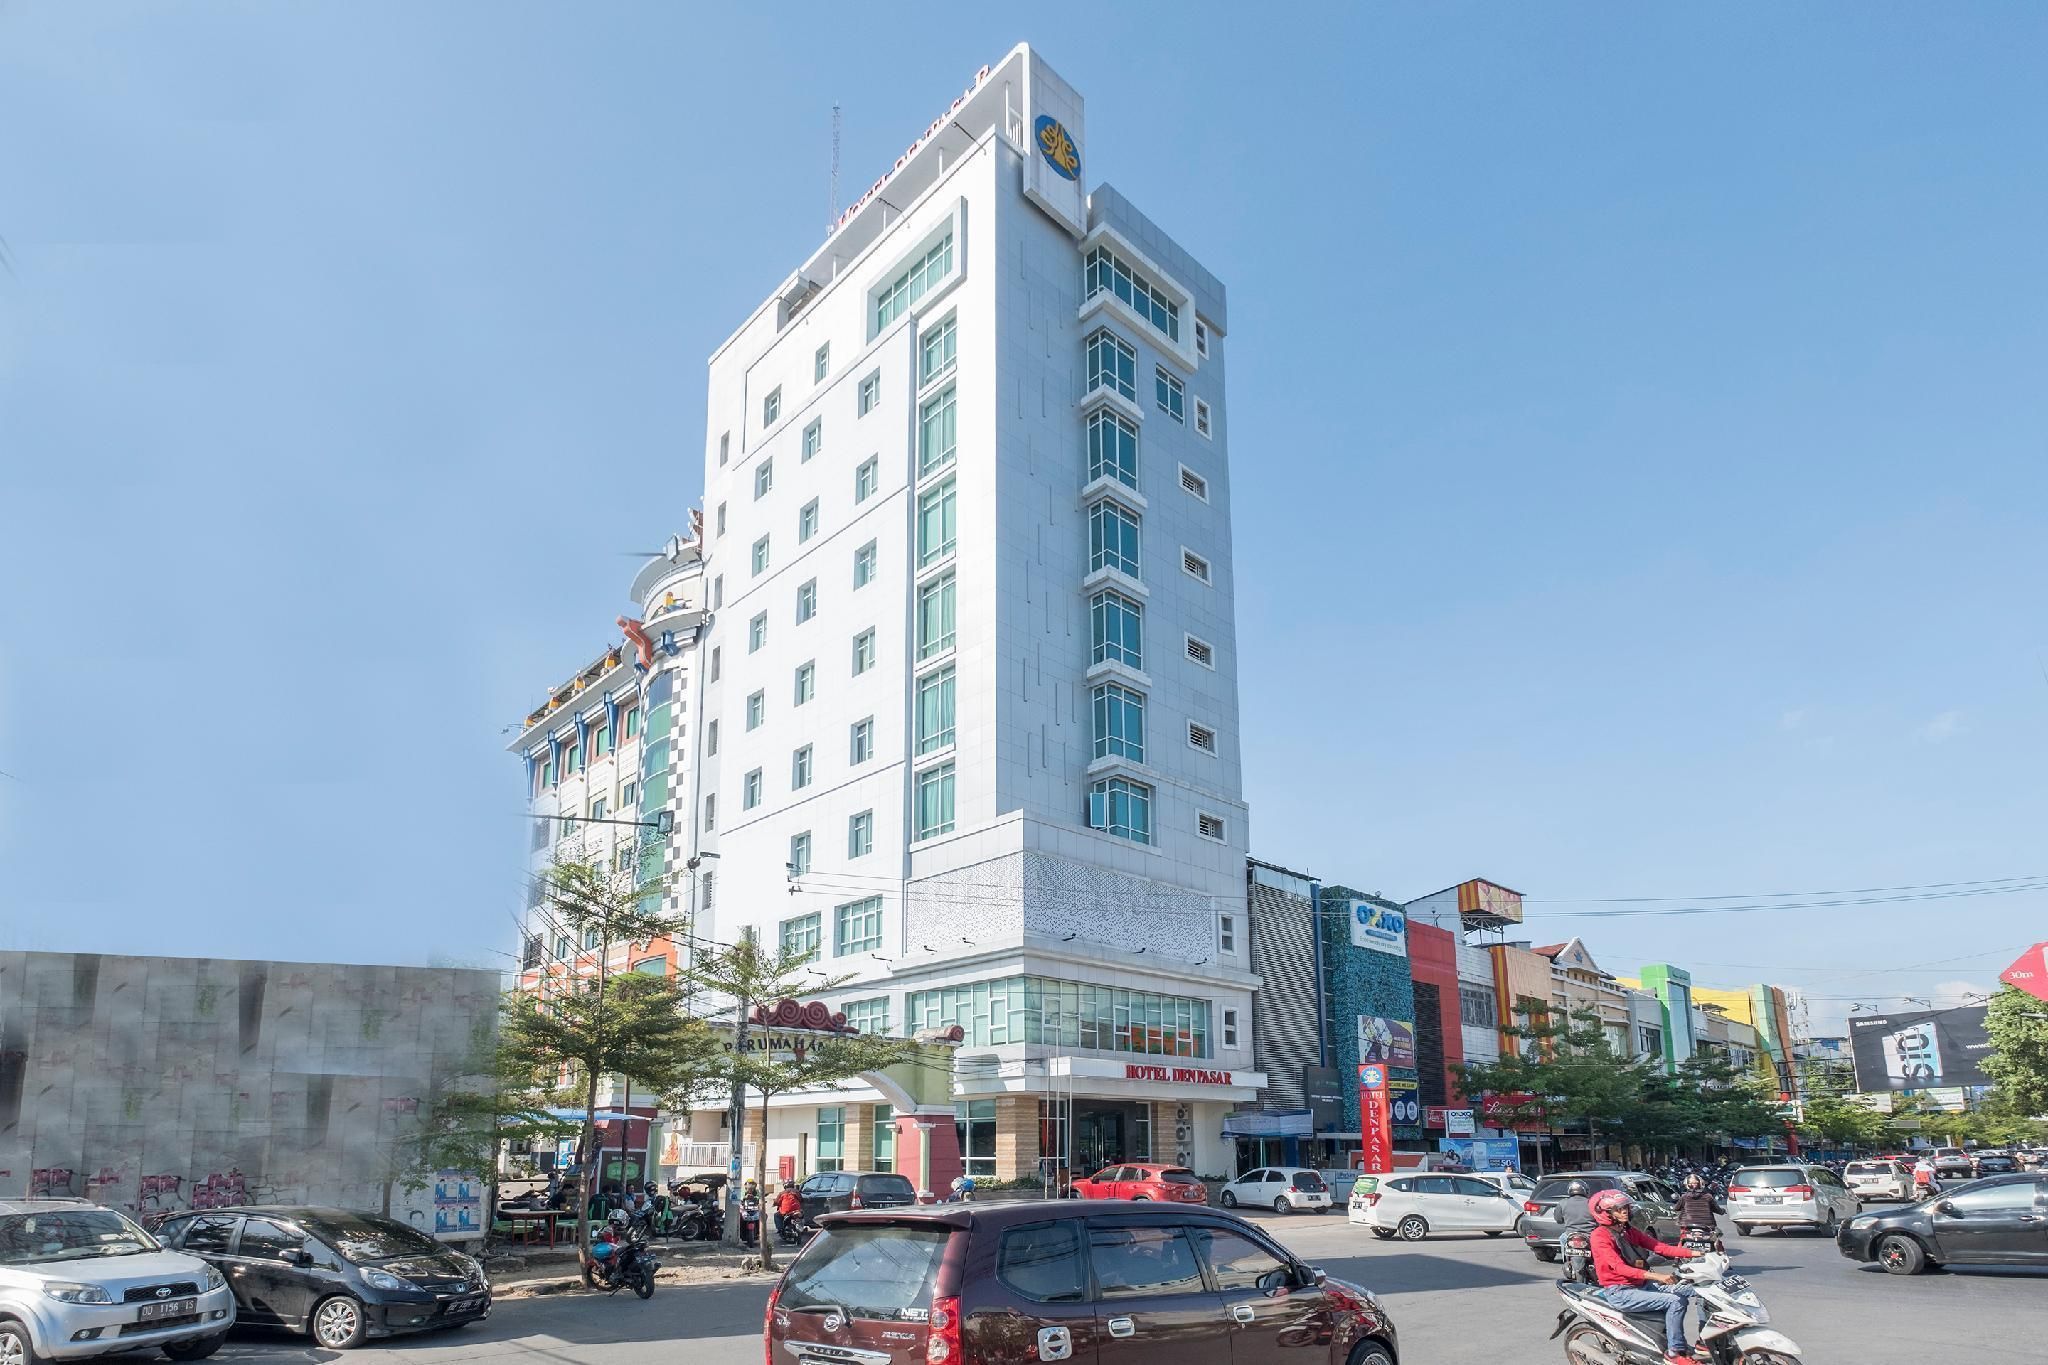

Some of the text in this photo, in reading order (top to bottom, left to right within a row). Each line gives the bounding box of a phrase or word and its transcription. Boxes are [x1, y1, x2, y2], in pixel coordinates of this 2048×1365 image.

[1855, 1019, 1888, 1027] SAMSUNG
[1126, 1064, 1233, 1085] HOTEL DENPASAR
[1361, 1091, 1385, 1099] HOTEL
[1368, 1100, 1382, 1171] DENPASAR
